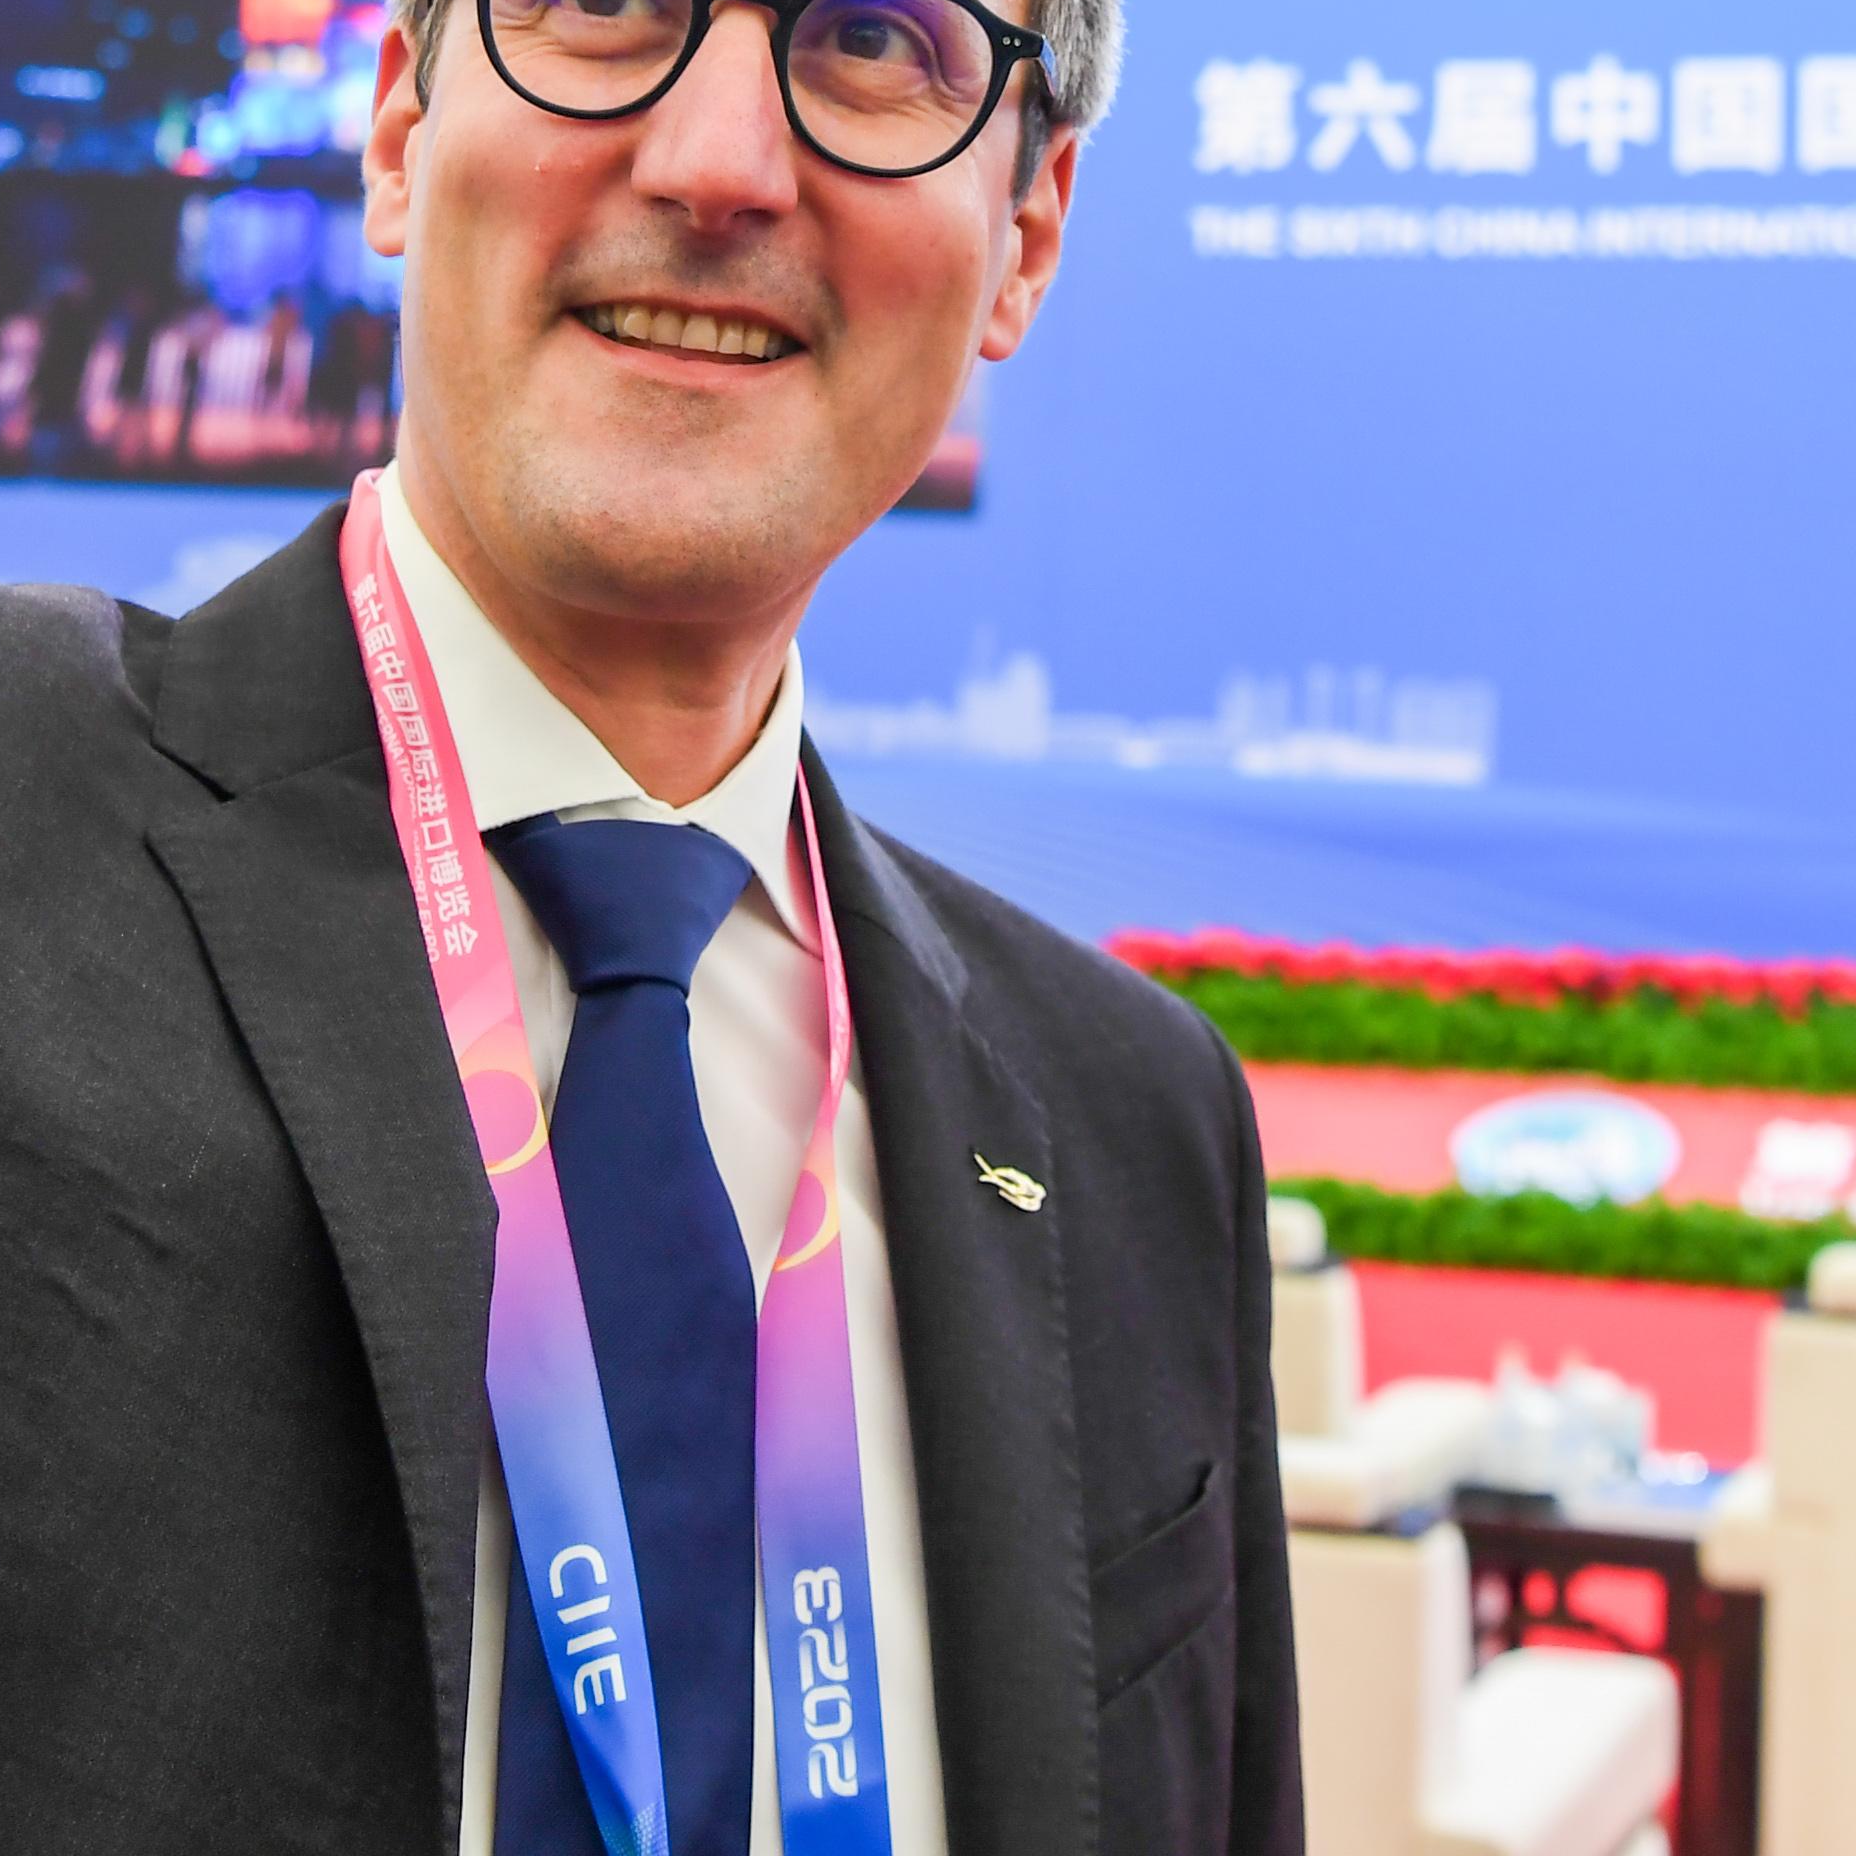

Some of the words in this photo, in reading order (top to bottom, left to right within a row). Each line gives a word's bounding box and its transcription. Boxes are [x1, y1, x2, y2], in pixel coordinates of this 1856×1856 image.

[351, 573, 479, 957] 第六届中国国际进口博览会
[548, 1543, 627, 1716] CIIE
[792, 1565, 858, 1800] 2023
